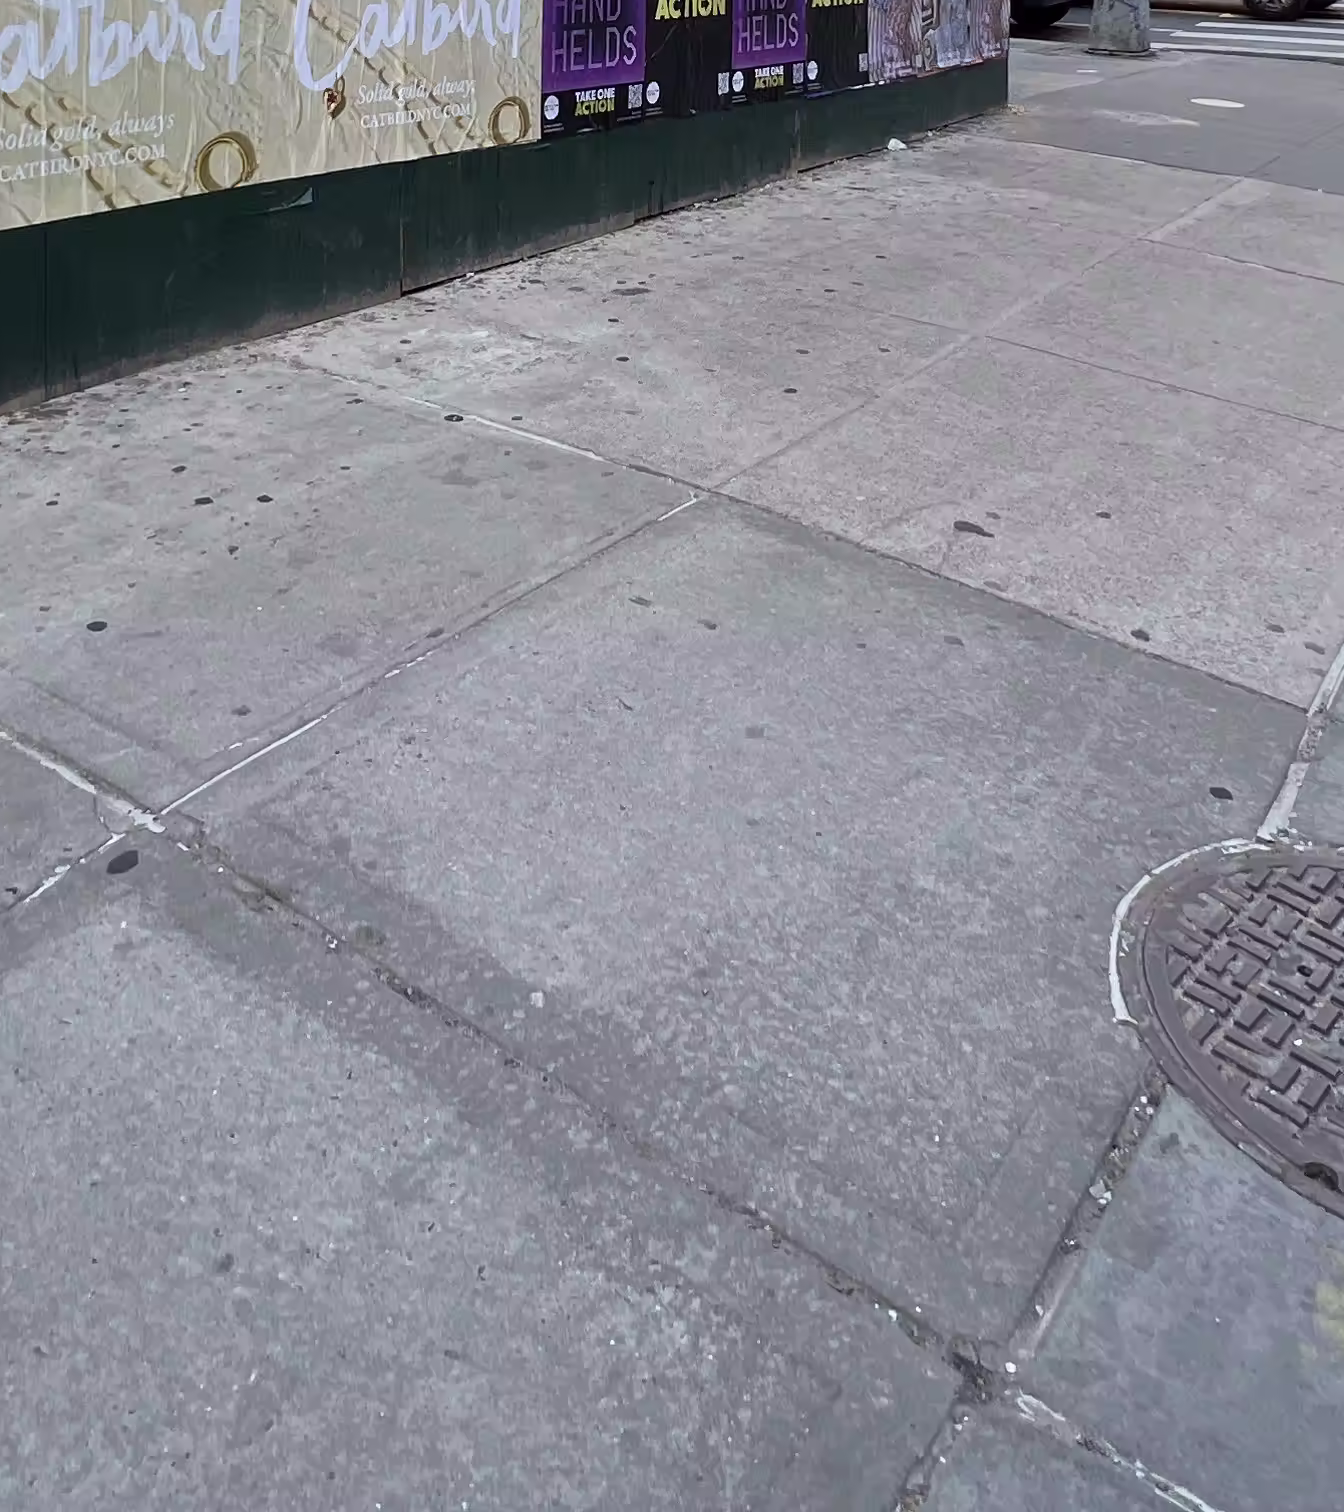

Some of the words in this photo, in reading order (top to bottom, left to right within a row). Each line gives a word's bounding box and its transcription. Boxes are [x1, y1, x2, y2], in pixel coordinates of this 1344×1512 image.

[737, 13, 799, 54] HELDS
[551, 25, 637, 73] HELDS
[754, 67, 769, 78] TAKE
[754, 75, 784, 88] ACTION
[358, 81, 394, 104] Solid
[575, 91, 597, 102] TAKE
[597, 88, 615, 99] ONE
[575, 100, 615, 116] ACTION
[49, 114, 101, 151] gold,
[108, 111, 175, 137] always
